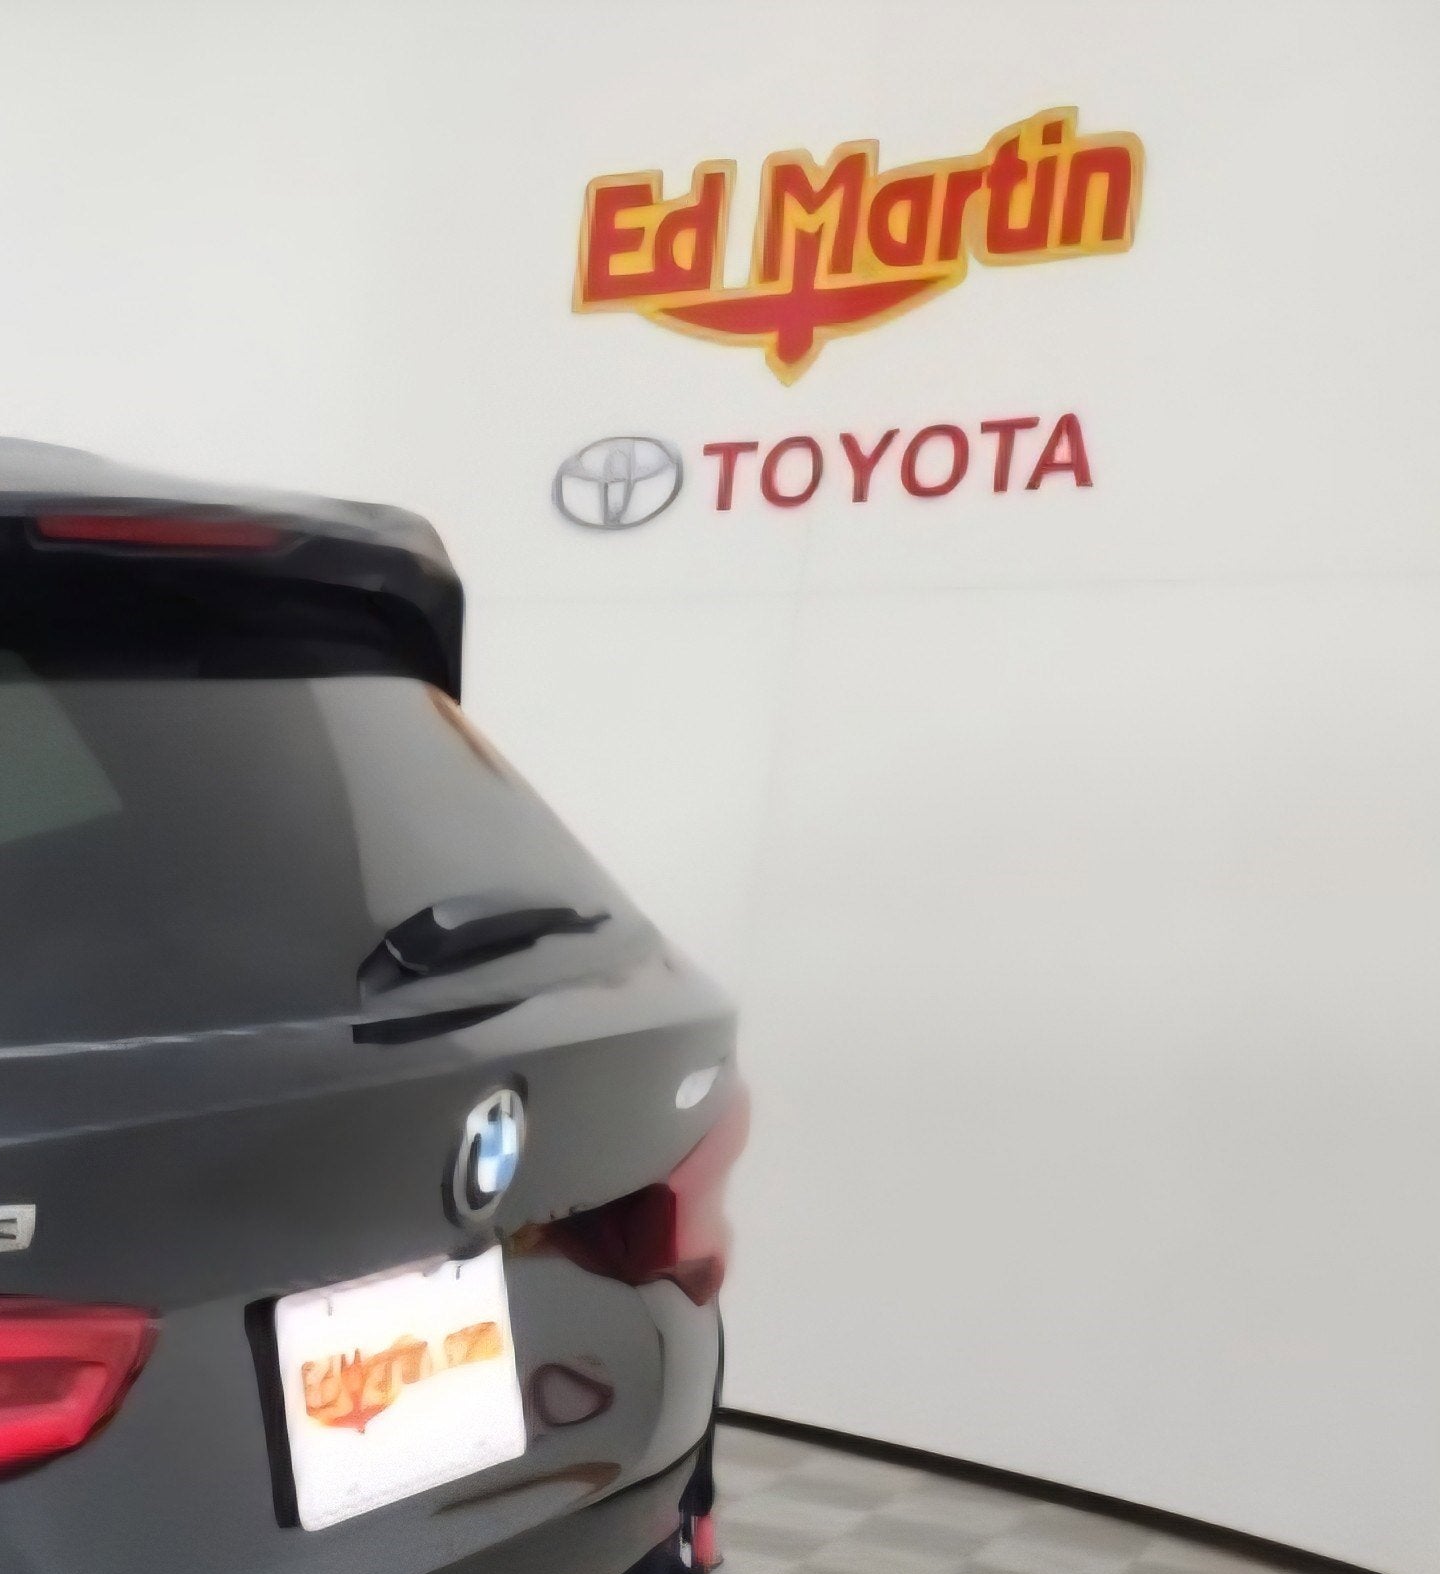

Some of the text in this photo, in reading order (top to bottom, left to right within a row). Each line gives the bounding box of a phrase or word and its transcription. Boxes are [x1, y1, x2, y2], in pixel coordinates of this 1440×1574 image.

[581, 119, 1134, 302] Ed Martin
[703, 412, 1094, 511] TOYOTA
